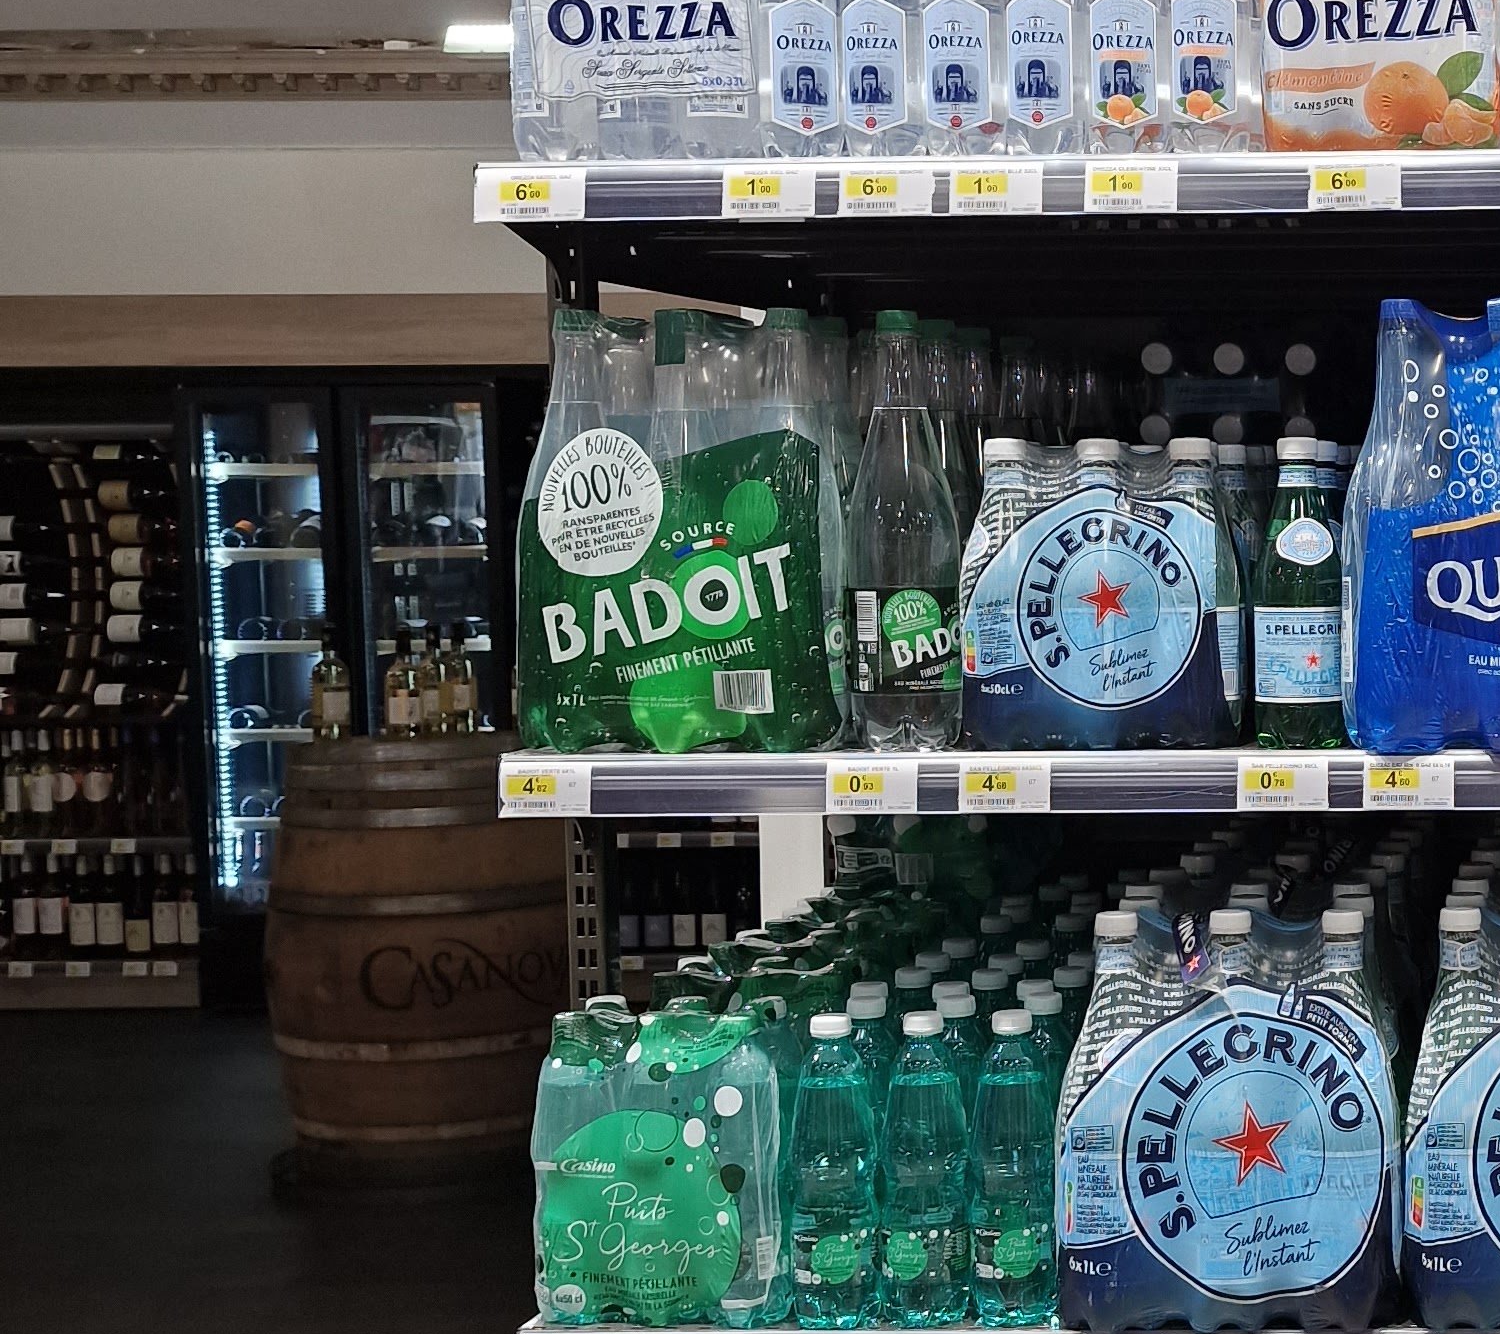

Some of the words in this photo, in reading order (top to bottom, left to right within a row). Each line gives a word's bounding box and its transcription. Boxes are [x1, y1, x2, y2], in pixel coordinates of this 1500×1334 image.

[777, 35, 832, 52] OREZZA
[846, 35, 898, 51] OREZZA
[928, 33, 983, 50] OREZZA
[1011, 29, 1065, 46] OREZZA
[1092, 33, 1154, 51] OREZZA
[1173, 28, 1234, 47] OREZZA
[1294, 100, 1321, 111] SANS
[1324, 96, 1354, 108] SUCRE
[541, 444, 581, 512] NOUVELLES
[585, 435, 651, 480] BOUTEILLES
[561, 463, 632, 513] 100%
[562, 506, 641, 528] RANSPARENTES
[552, 531, 573, 547] PUR
[575, 539, 591, 549] DE
[593, 528, 645, 546] NOUVELLES
[659, 521, 735, 552] SOURCE
[541, 542, 791, 664] BADOIT
[615, 654, 679, 684] FINEMENT
[682, 636, 757, 668] PÉTILLANTE
[1469, 654, 1488, 666] EAU
[1306, 1011, 1331, 1032] PETIT
[1330, 1024, 1359, 1056] FORMAT
[560, 1157, 616, 1174] Casino
[601, 1181, 675, 1222] Puits
[1224, 1215, 1311, 1257] Sublimez
[599, 1222, 722, 1275] Georges
[582, 1271, 630, 1287] FINEMENT
[632, 1275, 698, 1290] PÉTILLANTE
